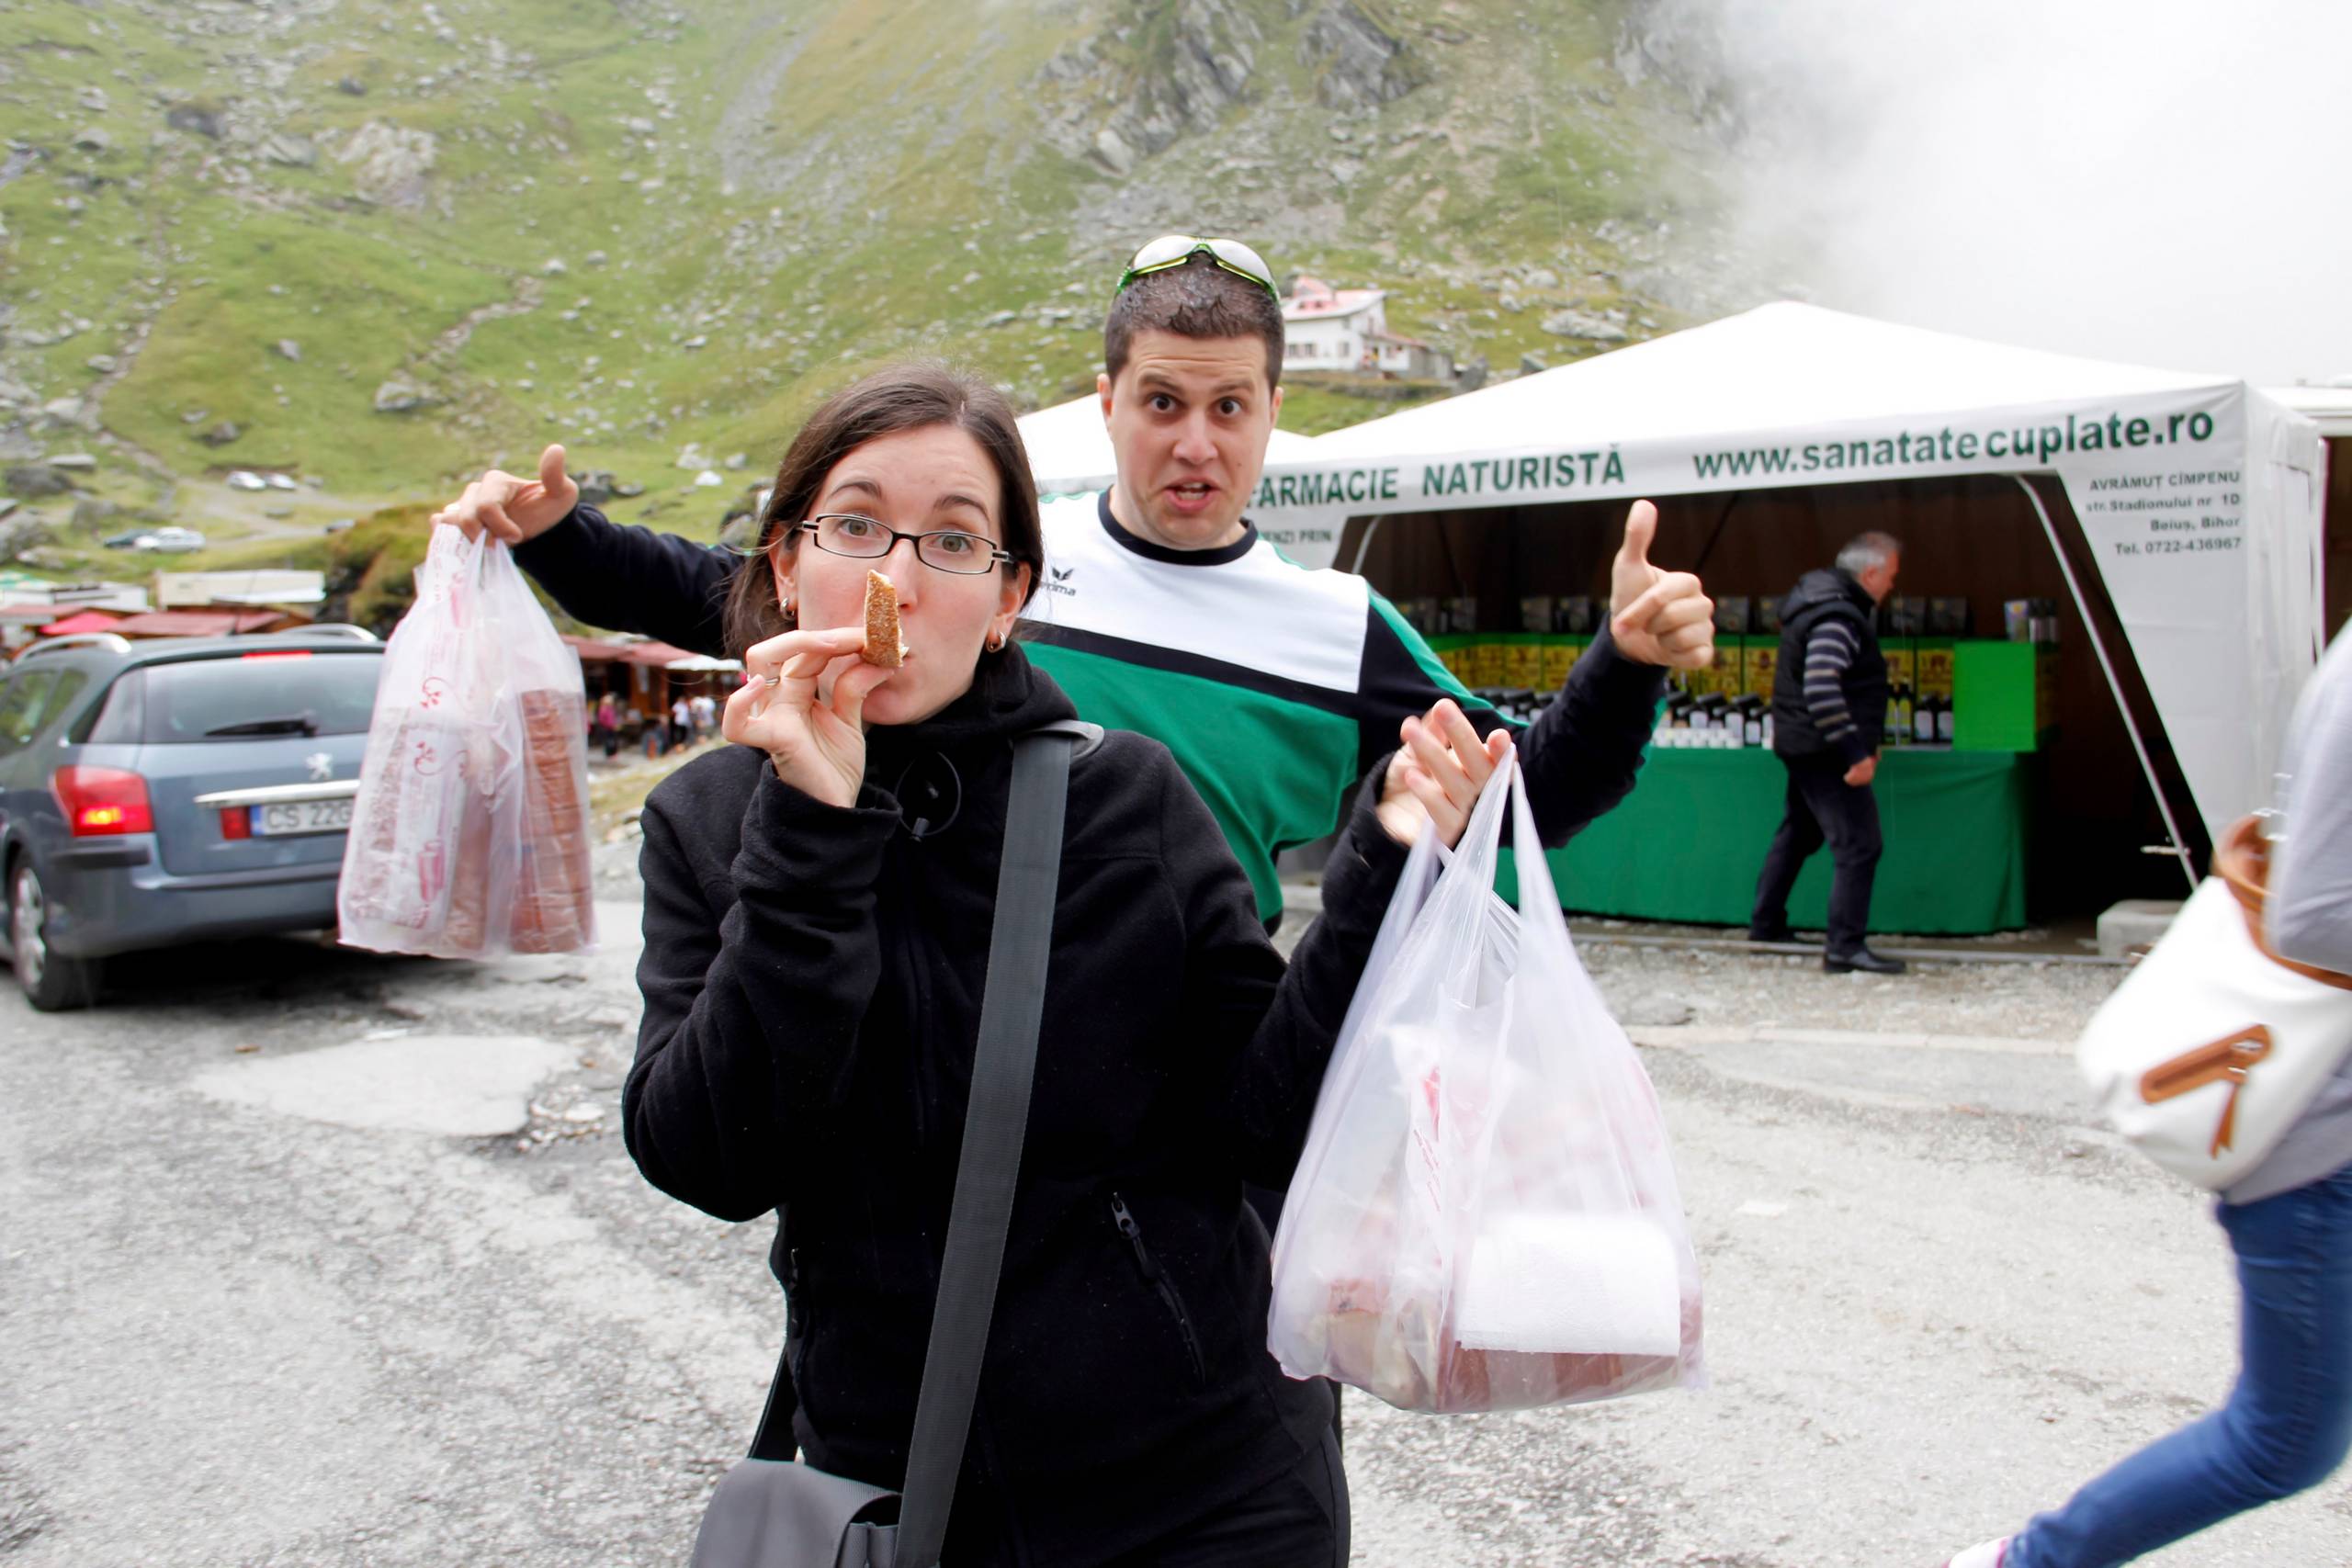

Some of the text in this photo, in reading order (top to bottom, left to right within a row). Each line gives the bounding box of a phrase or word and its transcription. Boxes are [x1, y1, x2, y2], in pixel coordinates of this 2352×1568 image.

[1693, 410, 2214, 479] www.sanatatecuplate.ro
[1423, 444, 1624, 496] NATURISTĂ
[2109, 494, 2192, 512] Stadionului
[2200, 514, 2241, 529] Bihor
[2115, 542, 2140, 555] Tel.
[266, 804, 301, 829] CS
